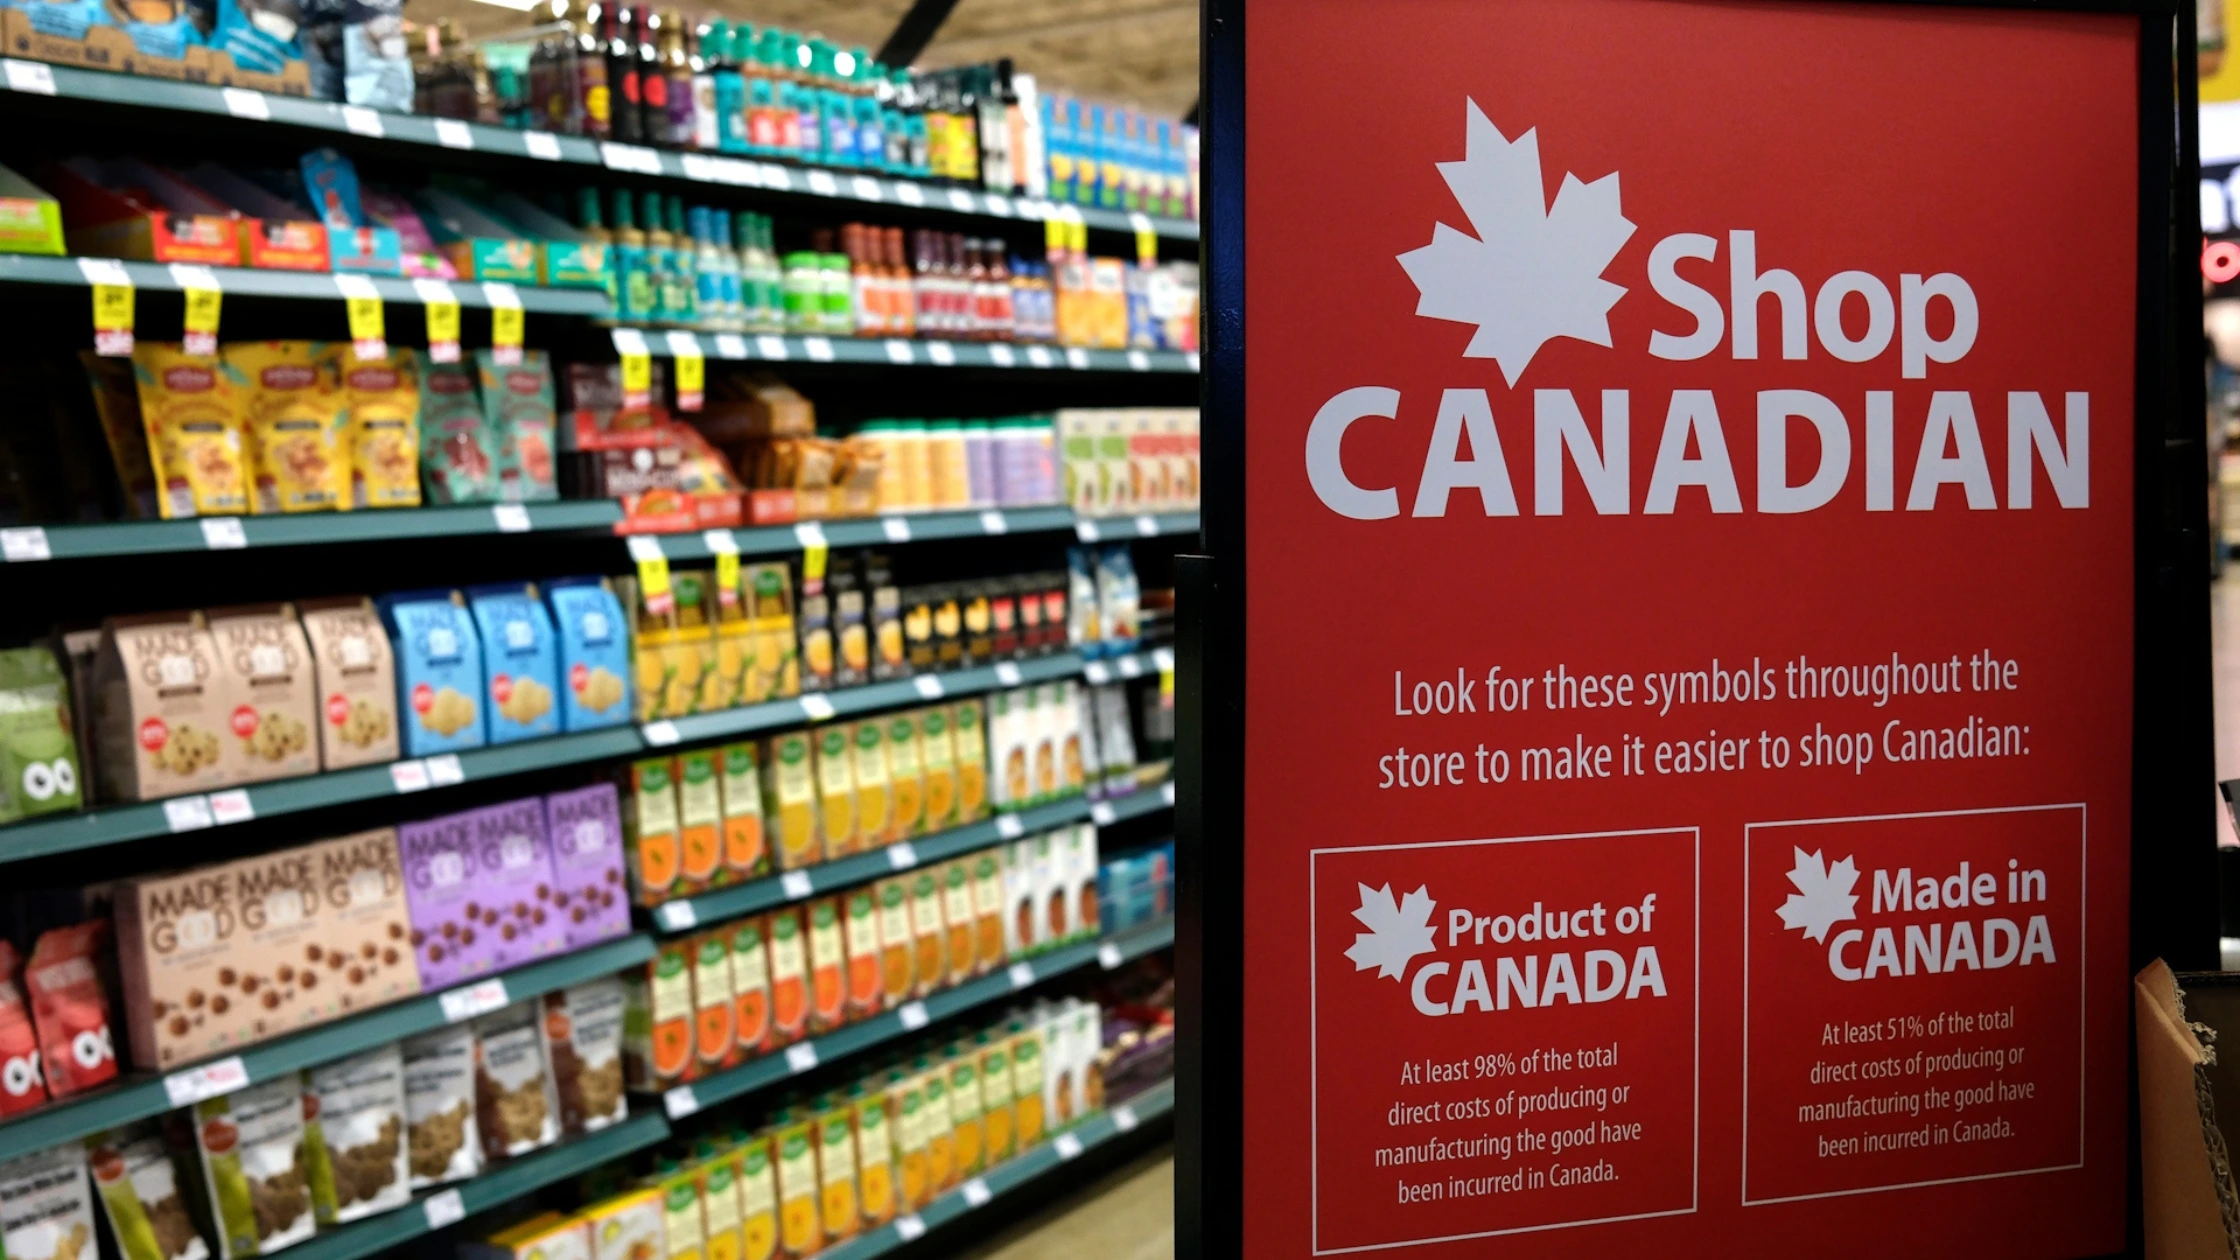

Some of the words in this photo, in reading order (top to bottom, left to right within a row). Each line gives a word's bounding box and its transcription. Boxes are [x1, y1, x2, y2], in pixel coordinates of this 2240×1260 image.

[1648, 230, 1979, 379] Shop
[1306, 386, 2089, 519] CANADIAN
[1396, 668, 1475, 715] Look
[1486, 666, 1533, 711] for
[1543, 664, 1633, 709] these
[1645, 658, 1775, 716] symbols
[1786, 653, 1961, 706] throughout
[1970, 649, 2018, 690] the
[1379, 748, 1464, 788] store
[1475, 744, 1510, 783] to
[1522, 734, 1611, 780] make
[1623, 734, 1644, 775] it
[1655, 730, 1750, 773] easier
[1759, 731, 1789, 768] to
[1800, 723, 1872, 774] shop
[1884, 716, 2029, 762] Canadian:
[236, 855, 317, 900] MADE
[322, 835, 393, 876] MADE
[149, 874, 232, 919] MADE
[1872, 867, 1997, 914] Made
[2008, 859, 2046, 903] in
[1448, 902, 1605, 947] Product
[1614, 893, 1657, 935] of
[1828, 915, 2056, 981] CANADA
[1411, 946, 1668, 1017] CANADA
[1822, 1023, 1840, 1045] At
[1845, 1021, 1883, 1043] least
[1887, 1015, 1924, 1040] 51%
[1928, 1012, 1945, 1035] of
[1948, 1010, 1974, 1033] the
[1978, 1006, 2014, 1031] total
[1401, 1061, 1421, 1085] At
[1427, 1059, 1469, 1083] least
[1474, 1052, 1516, 1078] 98%
[1521, 1049, 1540, 1074] of
[1543, 1048, 1572, 1072] the
[1577, 1042, 1617, 1069] total
[1811, 1061, 1857, 1084] direct
[1862, 1057, 1901, 1079] costs
[1905, 1051, 1923, 1075] of
[1926, 1047, 2004, 1078] producing
[2009, 1047, 2024, 1064] or
[1388, 1101, 1441, 1126] direct
[1446, 1097, 1490, 1120] costs
[1495, 1090, 1515, 1115] of
[1519, 1085, 1607, 1119] producing
[1612, 1085, 1630, 1104] or
[1799, 1092, 1919, 1122] manufacturing
[1924, 1087, 1950, 1109] the
[1955, 1081, 1993, 1112] good
[1999, 1080, 2034, 1101] have
[1375, 1133, 1511, 1167] manufacturing
[1517, 1128, 1546, 1152] the
[1551, 1121, 1595, 1155] good
[1601, 1120, 1641, 1143] have
[1819, 1135, 1858, 1157] been
[1864, 1124, 1929, 1152] incurred
[1934, 1124, 1948, 1144] in
[1953, 1116, 2014, 1142] Canada.
[1399, 1180, 1442, 1204] been
[1449, 1167, 1522, 1198] incurred
[1528, 1167, 1544, 1189] in
[1549, 1158, 1619, 1187] Canada.
